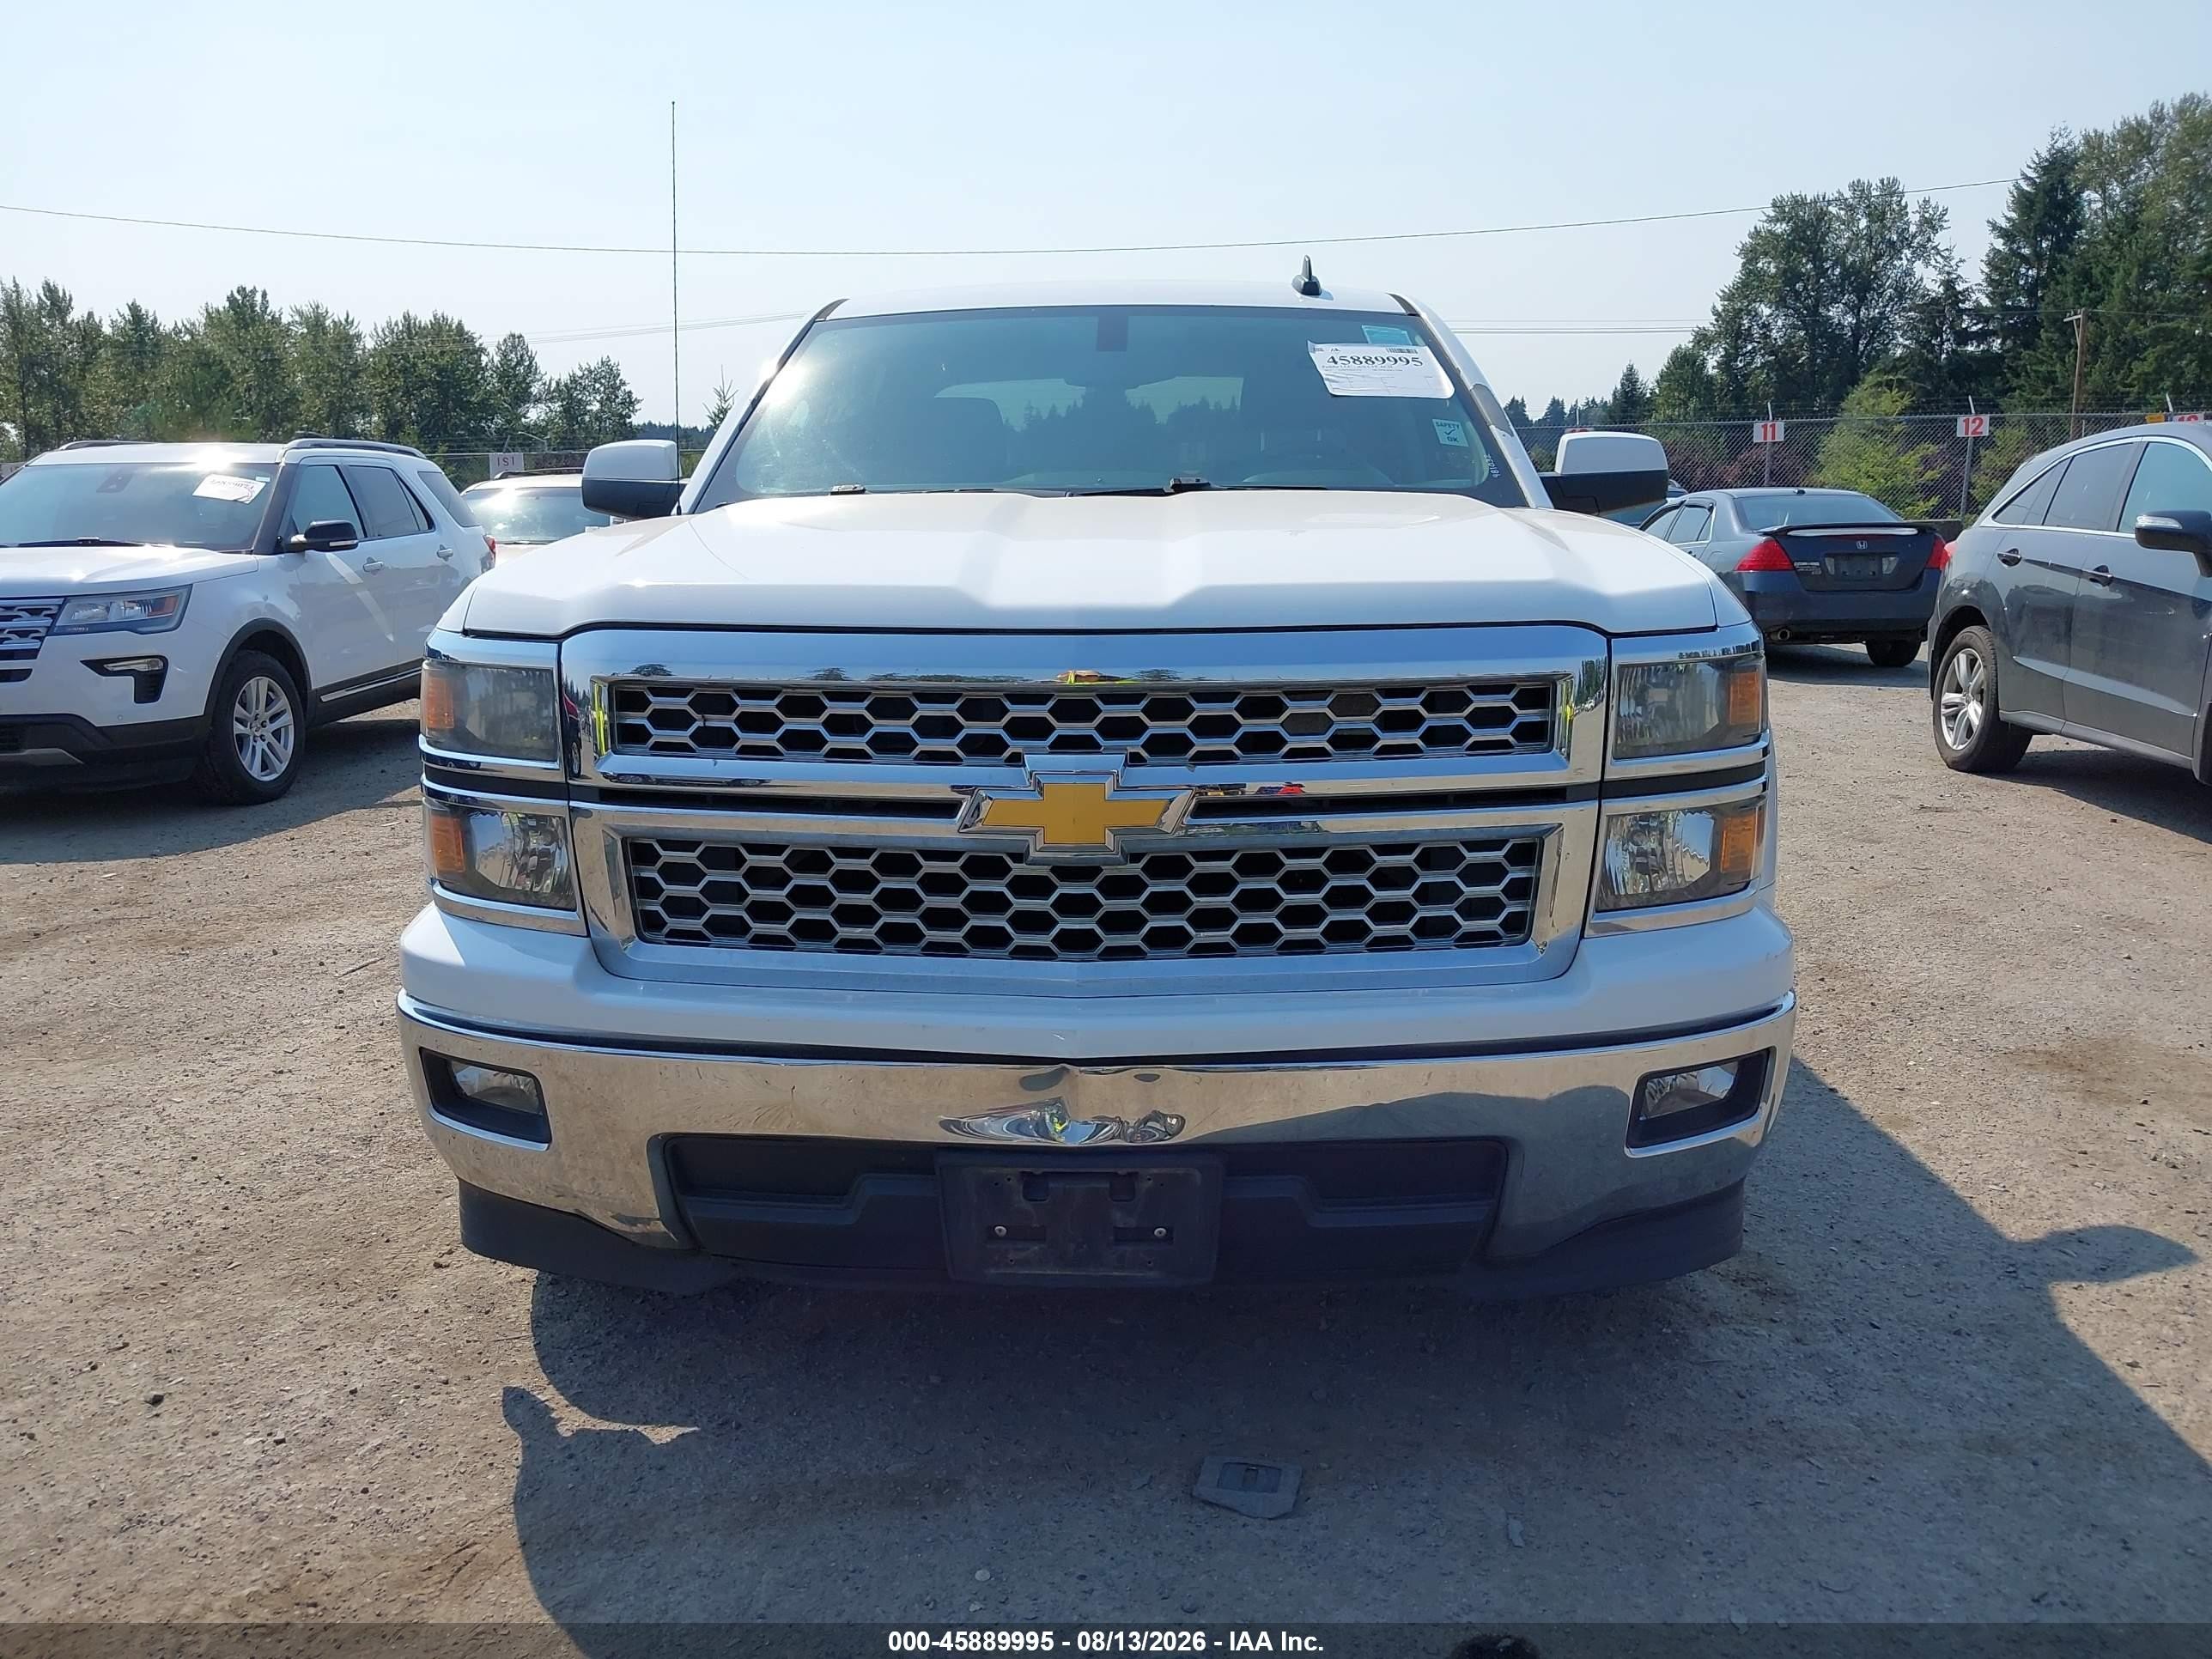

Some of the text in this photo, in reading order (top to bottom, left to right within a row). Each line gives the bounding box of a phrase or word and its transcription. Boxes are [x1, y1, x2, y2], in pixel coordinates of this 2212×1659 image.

[1327, 356, 1423, 367] 45889995
[1761, 422, 1776, 441] 11
[1963, 416, 1984, 435] 12
